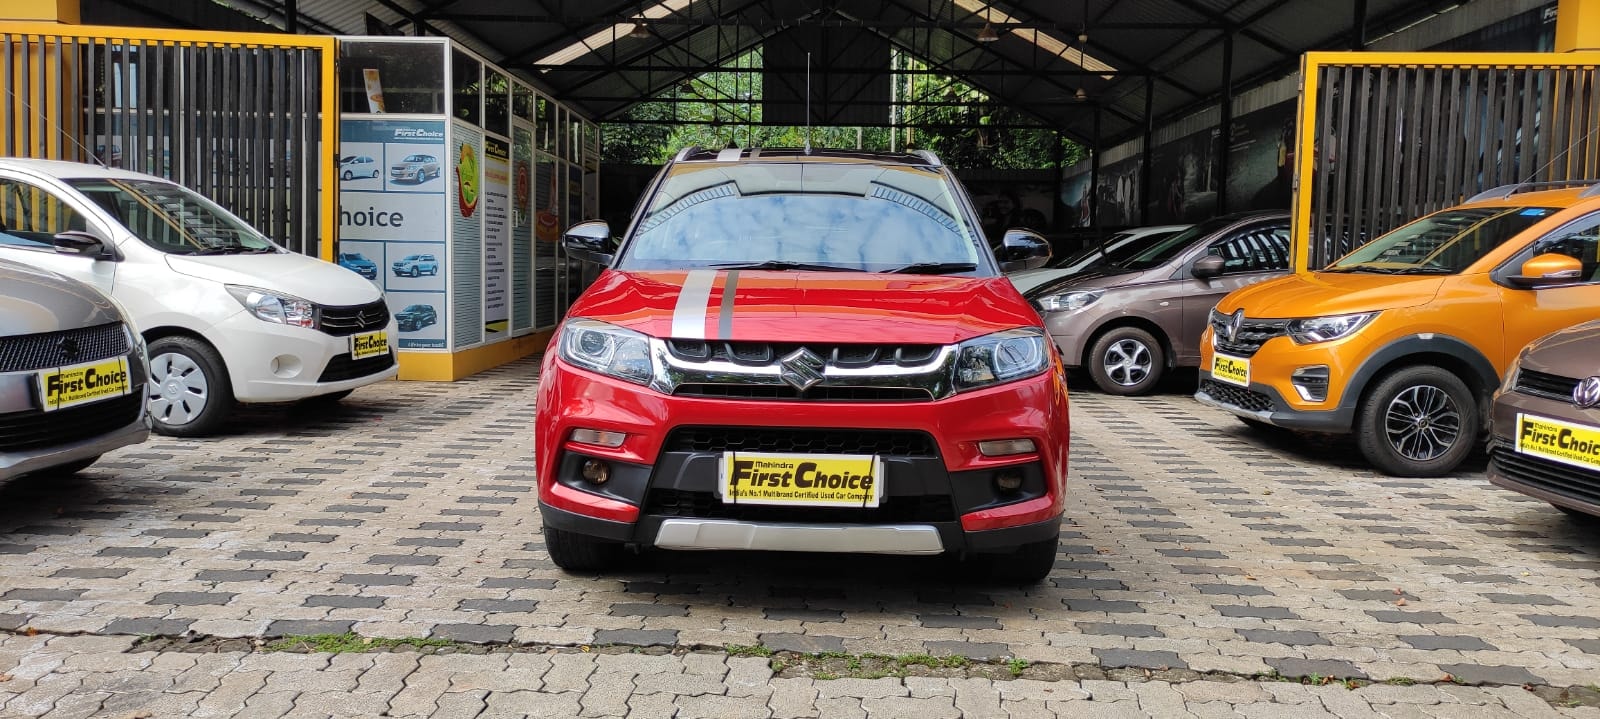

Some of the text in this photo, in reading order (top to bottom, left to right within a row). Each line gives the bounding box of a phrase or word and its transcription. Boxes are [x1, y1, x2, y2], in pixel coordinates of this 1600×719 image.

[394, 128, 444, 137] First Choice
[339, 205, 404, 227] hoice
[354, 337, 368, 351] First
[1214, 357, 1248, 377] First Choice
[47, 368, 127, 397] First Choice
[1520, 421, 1600, 456] First Choic
[730, 460, 874, 489] First Choice
[755, 461, 794, 469] Mahindra
[763, 490, 793, 498] Multibrand
[794, 491, 819, 499] Certified
